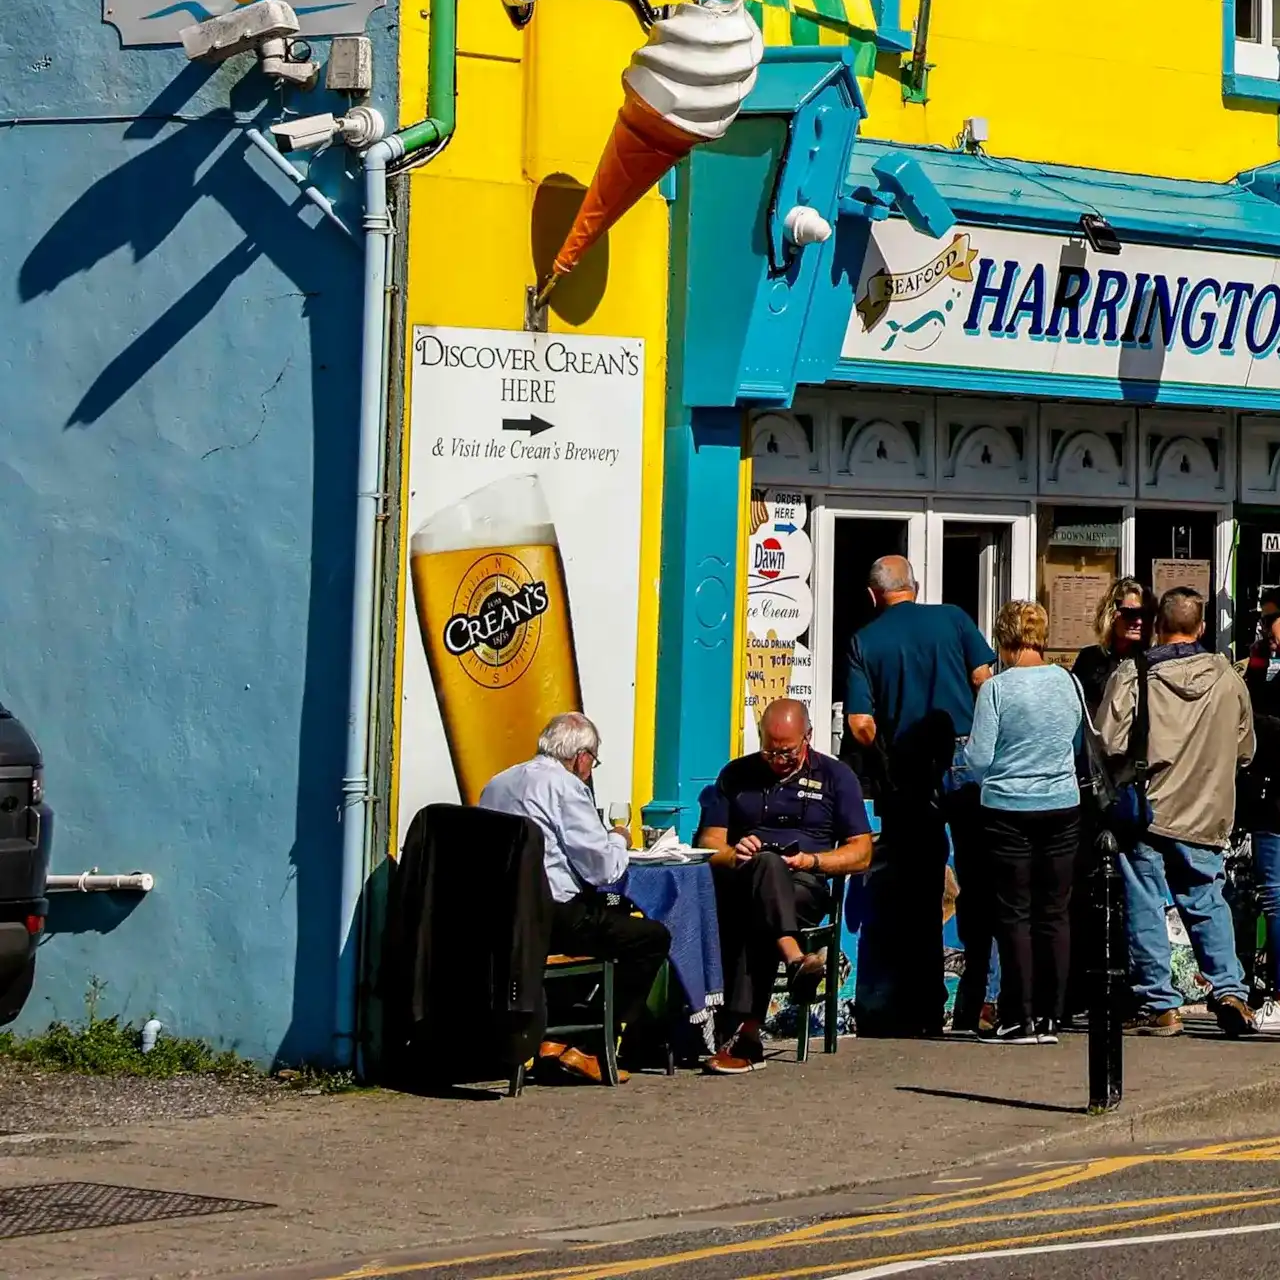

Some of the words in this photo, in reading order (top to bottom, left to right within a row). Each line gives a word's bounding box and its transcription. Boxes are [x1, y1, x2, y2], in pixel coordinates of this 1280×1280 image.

[884, 249, 958, 296] SEAFOOD
[416, 335, 540, 371] DISCOVER
[545, 342, 639, 375] CREAN'S
[501, 378, 556, 403] HERE
[432, 437, 444, 456] &
[451, 438, 480, 458] Visit
[484, 439, 506, 458] the
[511, 440, 560, 460] Crean's
[565, 442, 619, 466] Brewery
[776, 494, 801, 505] ORDER
[775, 508, 794, 519] HERE
[754, 543, 785, 569] Dawn
[446, 585, 547, 651] CREAN'S
[747, 607, 758, 618] ce
[762, 599, 800, 618] Cream
[752, 639, 769, 648] COLD
[772, 639, 795, 649] DRINKS
[787, 657, 811, 667] DRINKS
[493, 673, 499, 683] S
[786, 685, 812, 695] SWEETS
